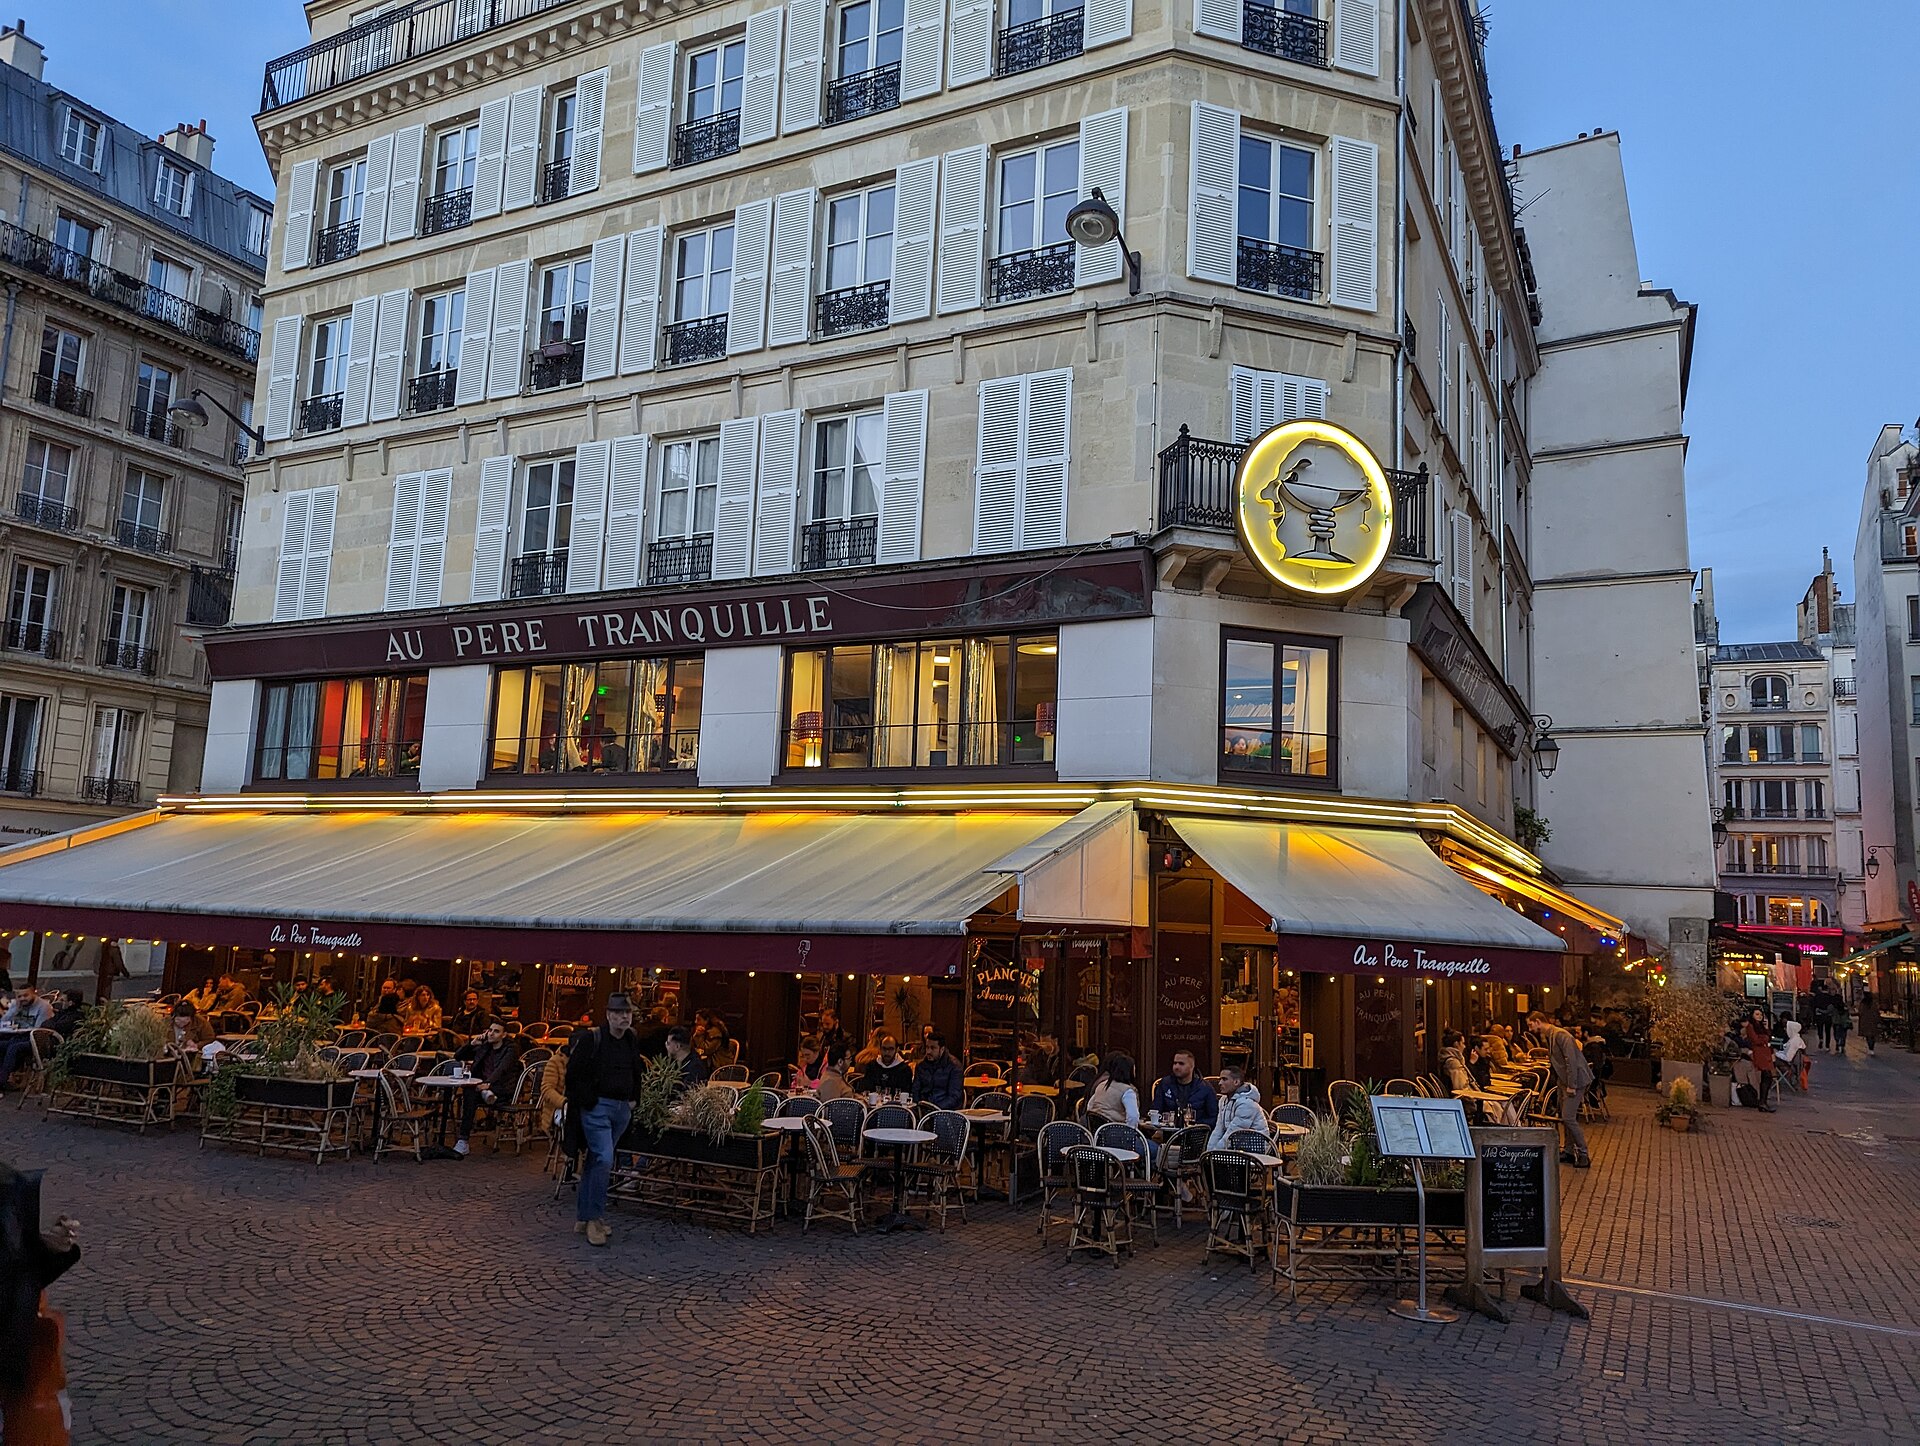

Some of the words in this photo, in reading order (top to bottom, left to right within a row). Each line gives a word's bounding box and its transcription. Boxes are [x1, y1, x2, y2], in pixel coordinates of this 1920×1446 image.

[385, 629, 424, 662] AU
[452, 619, 547, 658] PERE
[578, 596, 834, 648] TRANQUILLE
[1440, 635, 1461, 671] AU
[1, 825, 25, 834] Maison
[270, 924, 286, 943] Au
[310, 926, 362, 950] Tranquille
[1353, 944, 1378, 966] Au
[1384, 943, 1409, 969] Père
[1413, 948, 1491, 977] Tranquille
[1164, 977, 1177, 989] AU
[1179, 976, 1203, 990] PERE
[1159, 993, 1208, 1012] TRANQUILLE
[1359, 989, 1371, 1001] AU
[1373, 988, 1396, 1001] PERE
